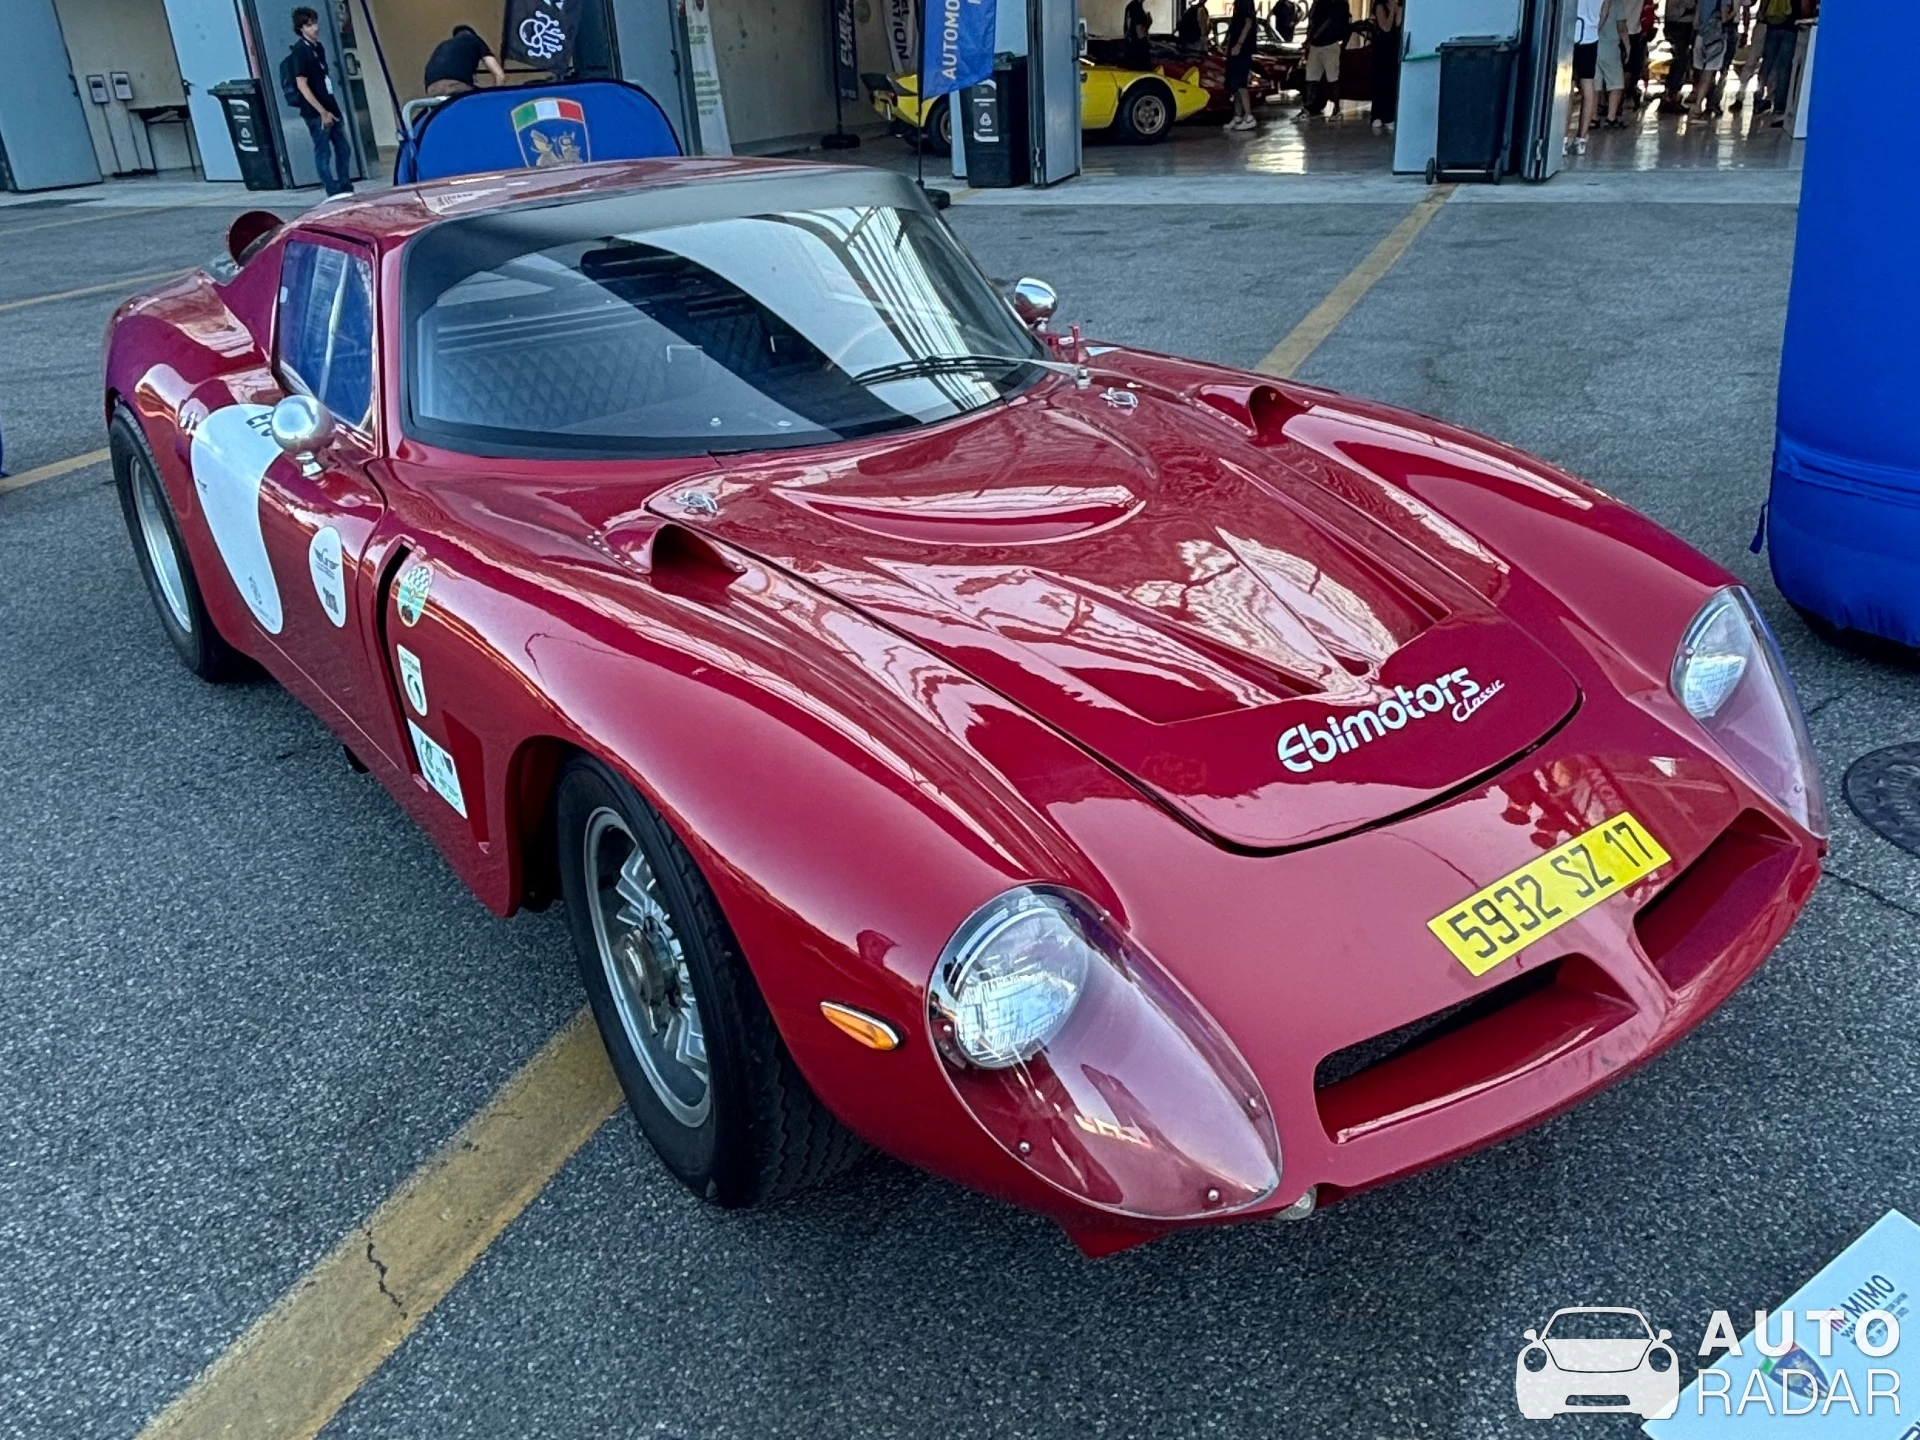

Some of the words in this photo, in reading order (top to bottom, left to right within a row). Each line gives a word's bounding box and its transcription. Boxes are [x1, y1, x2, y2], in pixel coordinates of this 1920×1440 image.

[1277, 667, 1480, 773] Ebimotors
[1452, 679, 1505, 723] Classic
[1446, 873, 1563, 959] 5932
[1550, 843, 1615, 898] SZ
[1603, 821, 1653, 868] 17
[1840, 1274, 1895, 1320] MIMO
